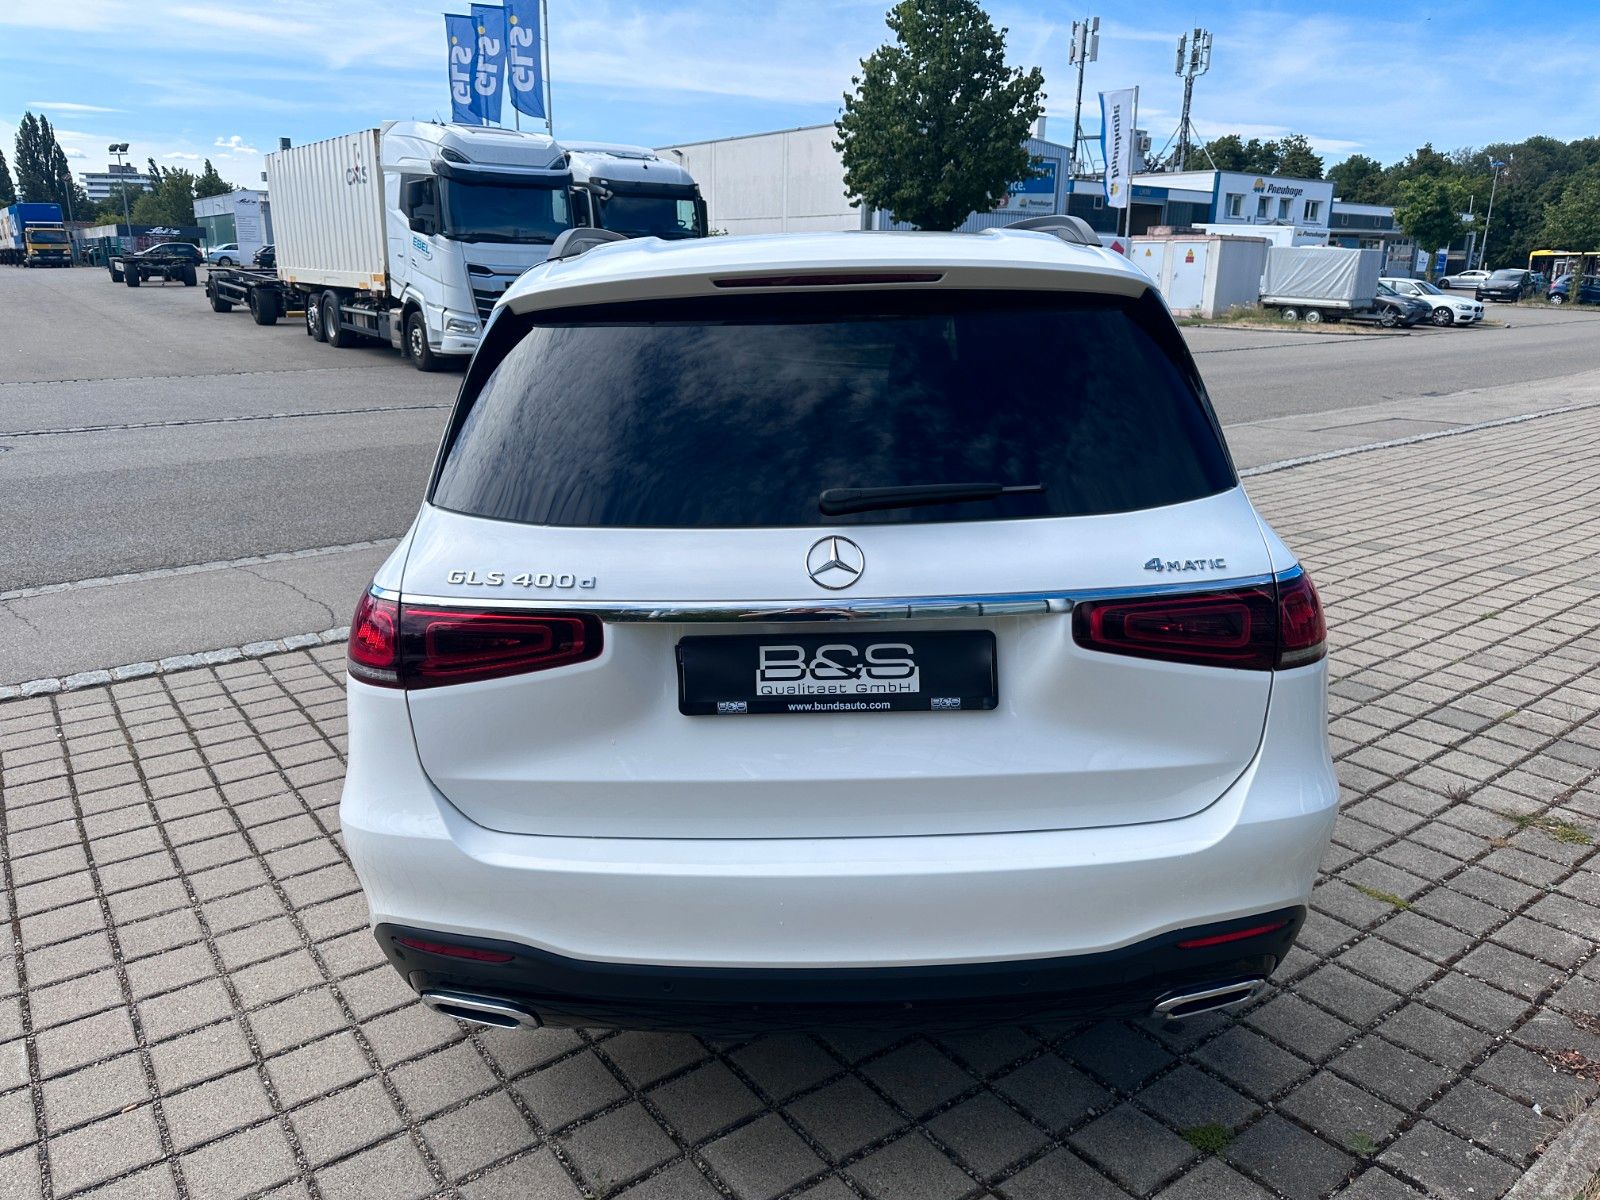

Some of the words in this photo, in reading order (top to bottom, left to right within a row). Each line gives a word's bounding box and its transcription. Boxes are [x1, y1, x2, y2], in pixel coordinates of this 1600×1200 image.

[1267, 184, 1303, 197] Pneuhage
[1144, 557, 1227, 572] 4MATIC
[447, 570, 505, 586] GLS
[759, 643, 915, 682] B&S
[760, 683, 848, 695] Qualitaet
[787, 701, 891, 712] www.bundsauto.com
